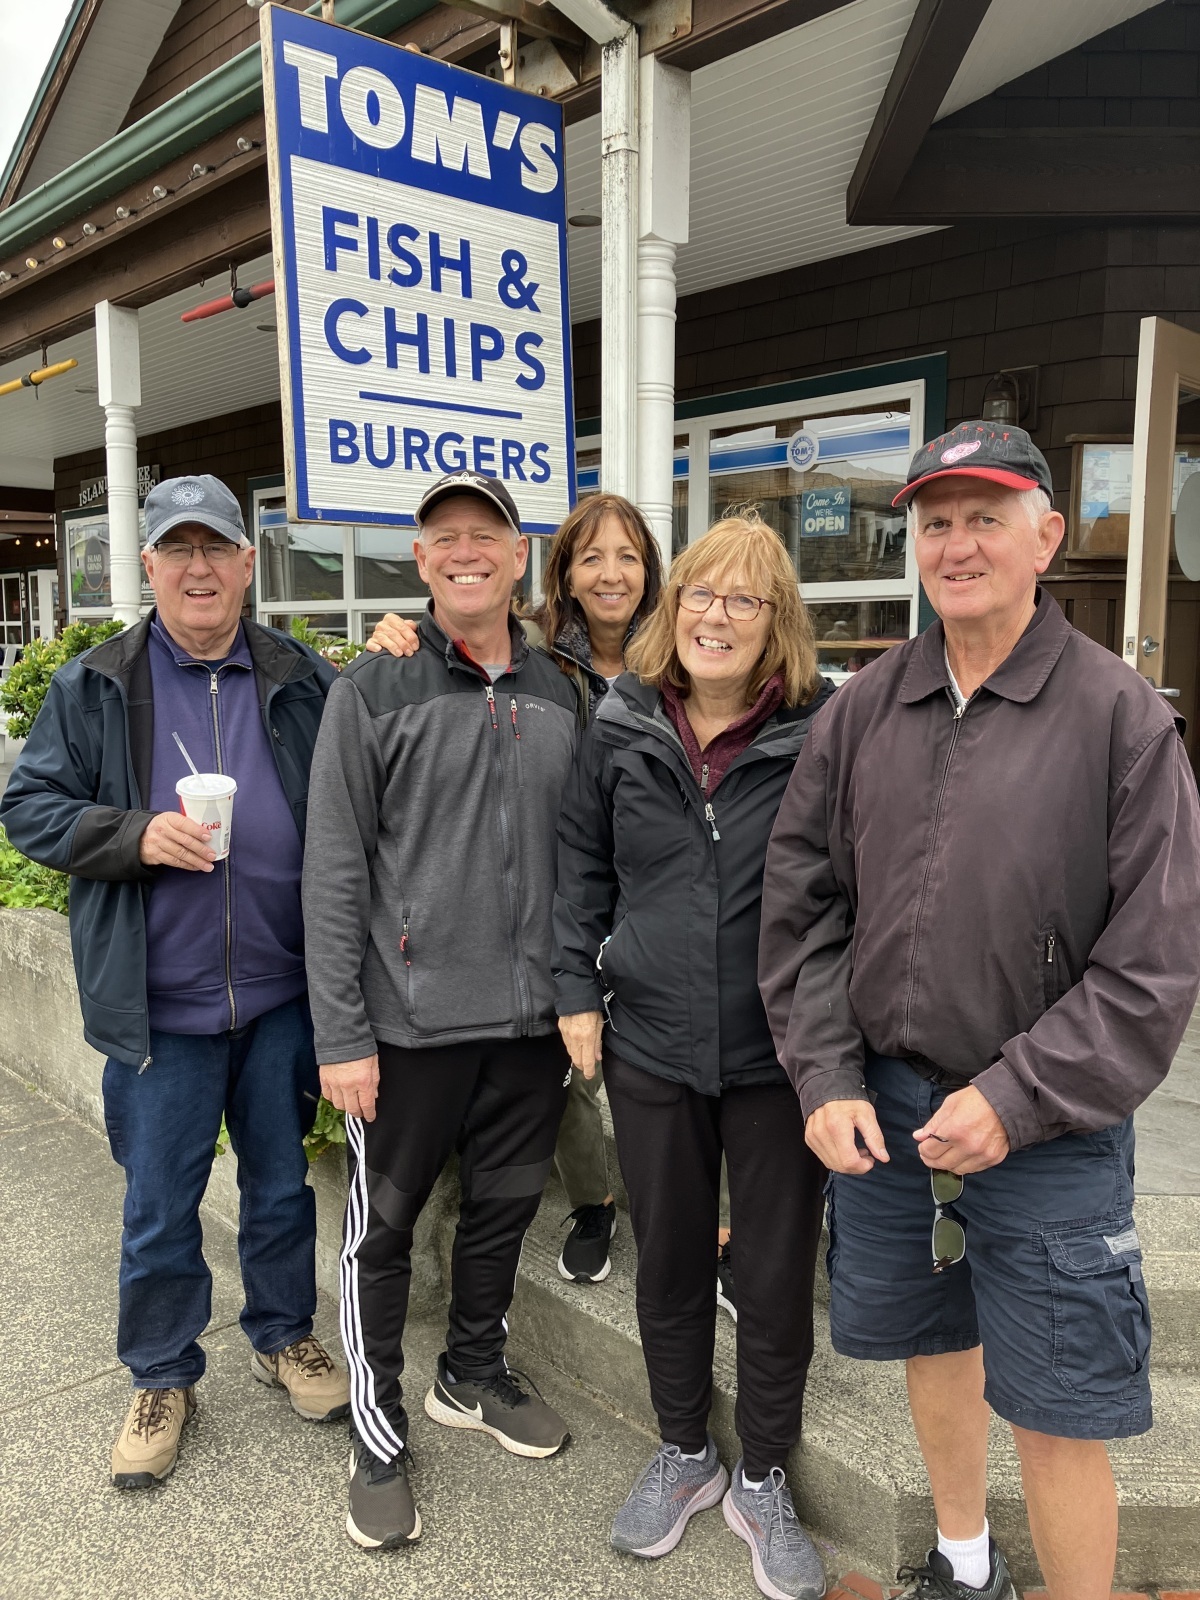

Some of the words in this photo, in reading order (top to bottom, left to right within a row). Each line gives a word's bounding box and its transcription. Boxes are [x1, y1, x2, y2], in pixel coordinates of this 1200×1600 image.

[283, 40, 559, 194] TOM'S
[322, 205, 473, 299] FISH
[497, 248, 541, 313] &
[324, 298, 546, 391] CHIPS
[329, 418, 551, 484] BURGERS
[790, 446, 815, 456] TOM'S
[806, 493, 830, 510] Come
[832, 491, 846, 506] In
[815, 508, 834, 517] WE'RE
[804, 515, 845, 533] OPEN
